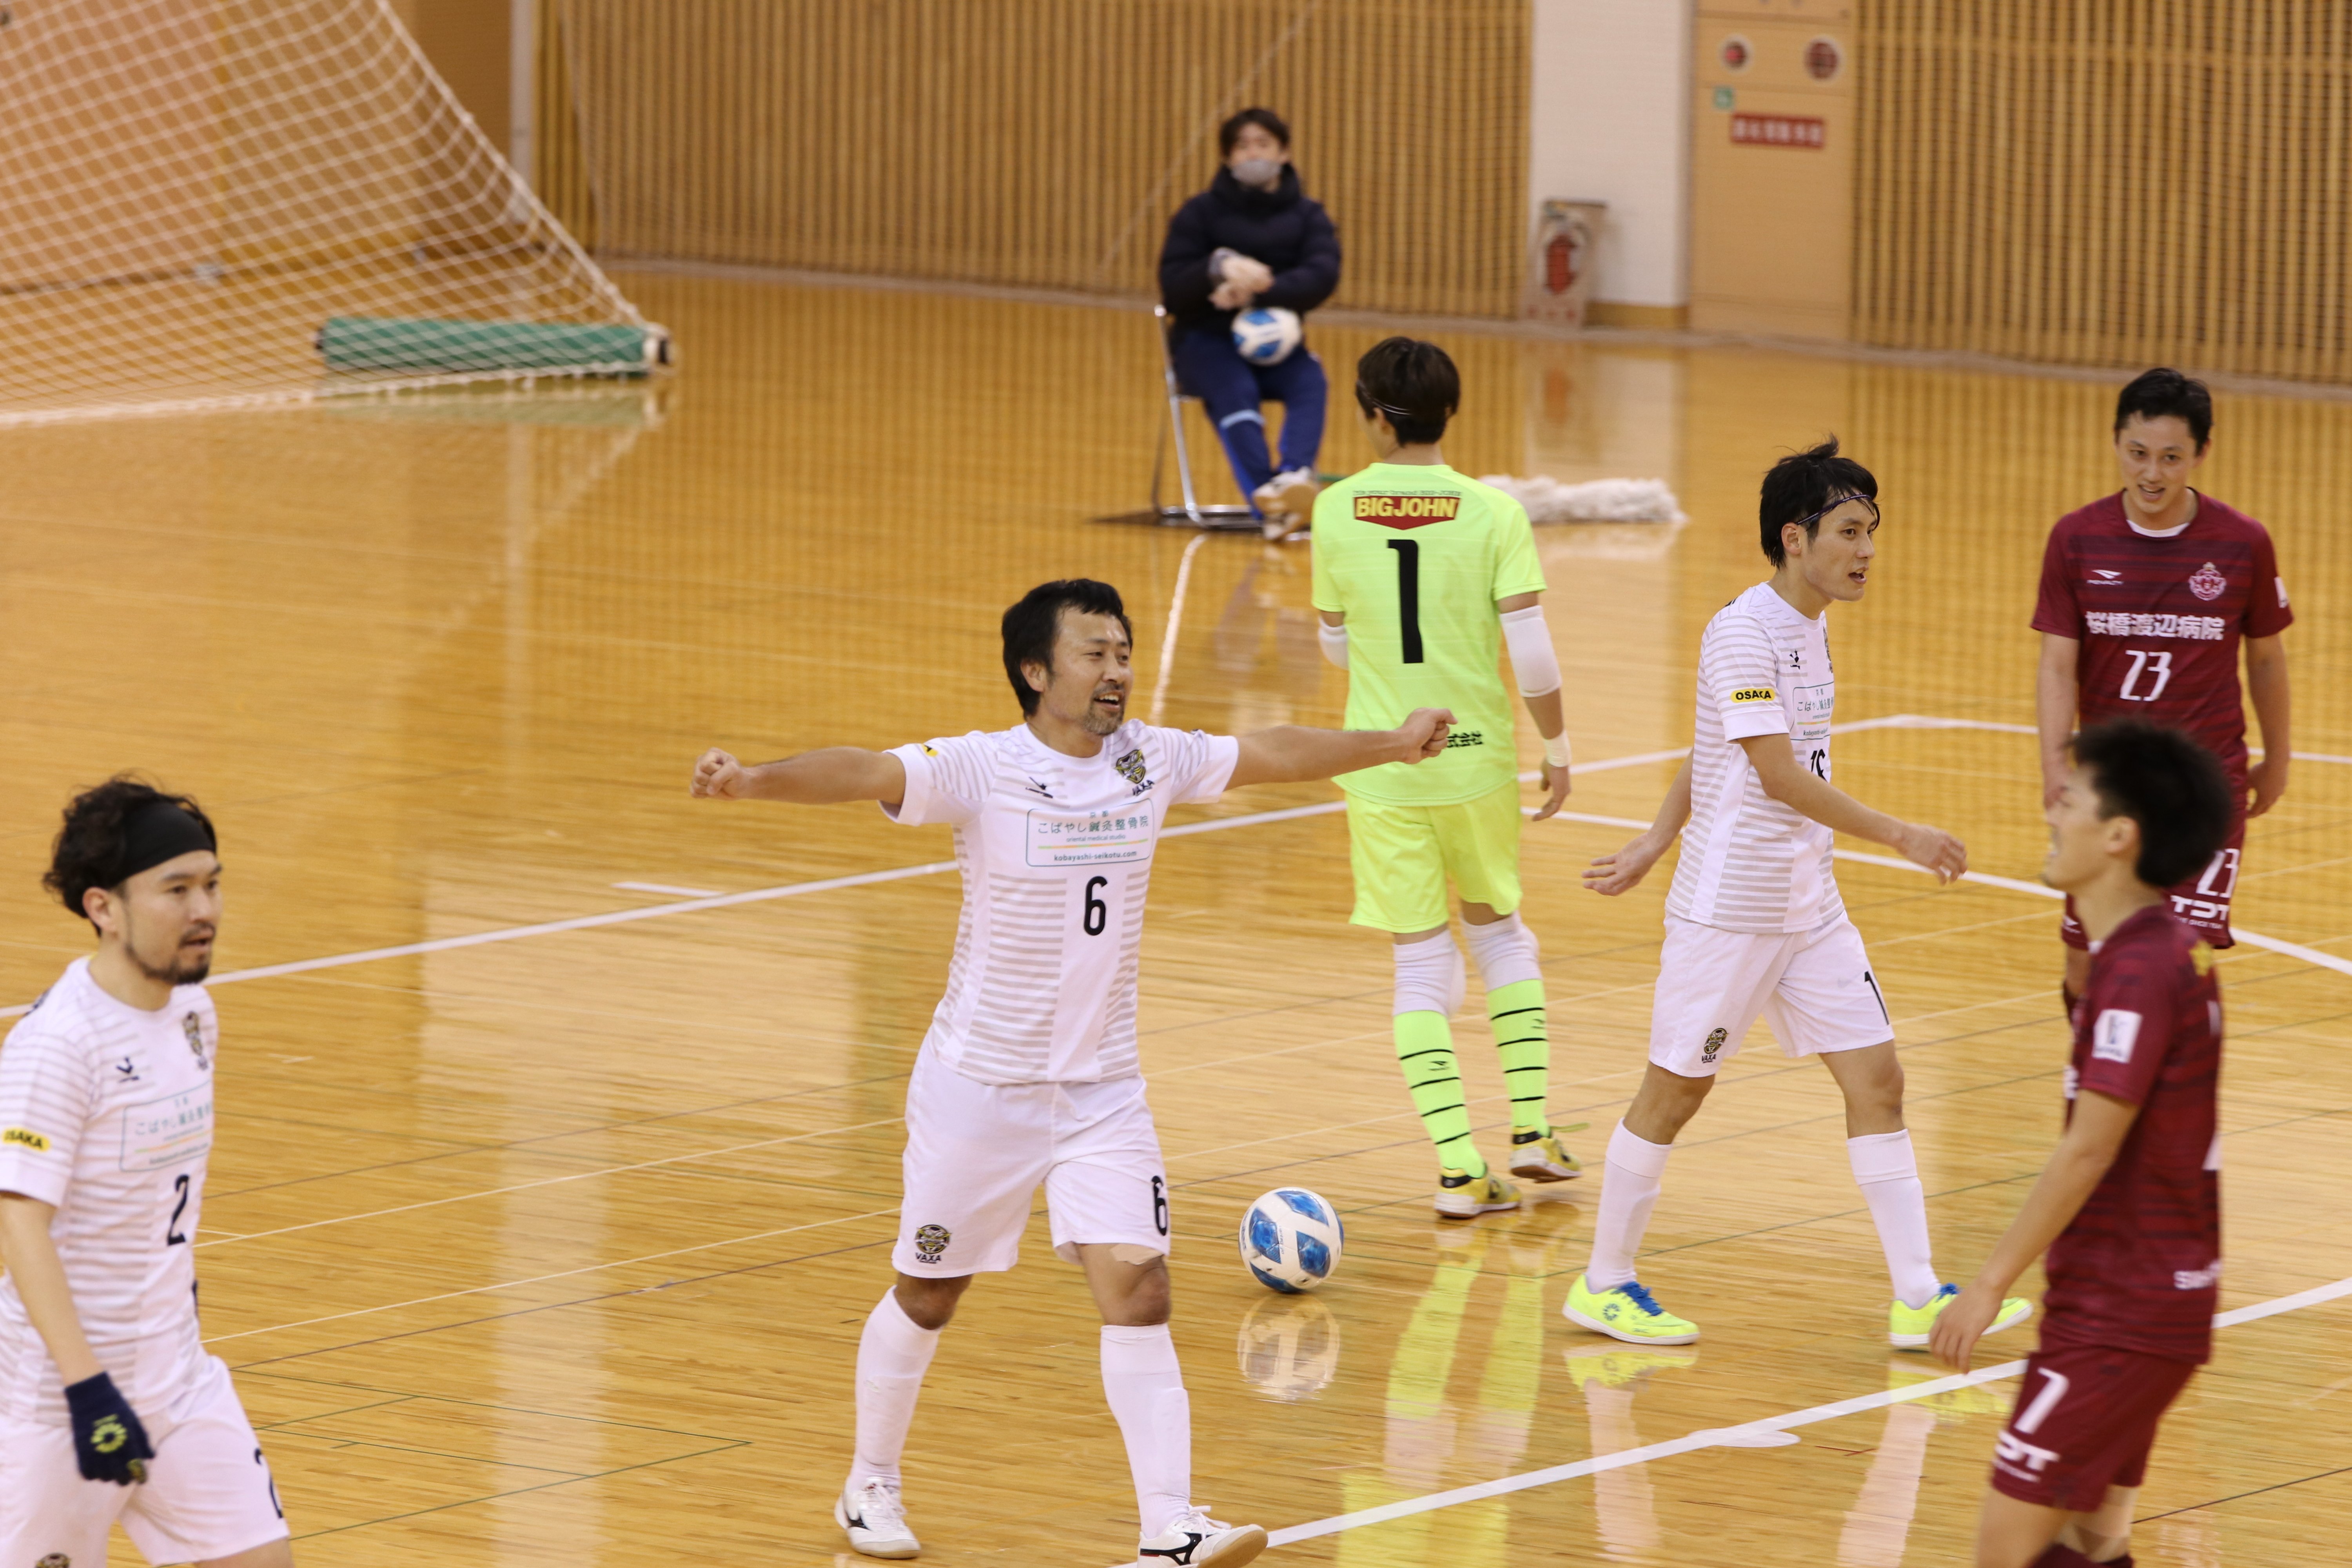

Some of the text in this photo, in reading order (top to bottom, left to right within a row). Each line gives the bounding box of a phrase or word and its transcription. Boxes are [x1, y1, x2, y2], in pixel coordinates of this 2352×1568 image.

[1387, 539, 1424, 664] 1
[2085, 611, 2225, 641] 桜橋渡辺病院
[1735, 690, 1772, 701] OSAKA
[2120, 649, 2172, 702] 23
[1038, 815, 1149, 834] こばやし鍼灸整骨院
[1054, 850, 1137, 862] kobayashi-seikotu.com
[1083, 876, 1108, 936] 6
[1701, 1053, 1716, 1062] VAXA
[167, 1174, 190, 1246] 2
[1151, 1175, 1167, 1236] 6
[915, 1252, 942, 1261] VAXA
[2013, 1367, 2069, 1435] 7
